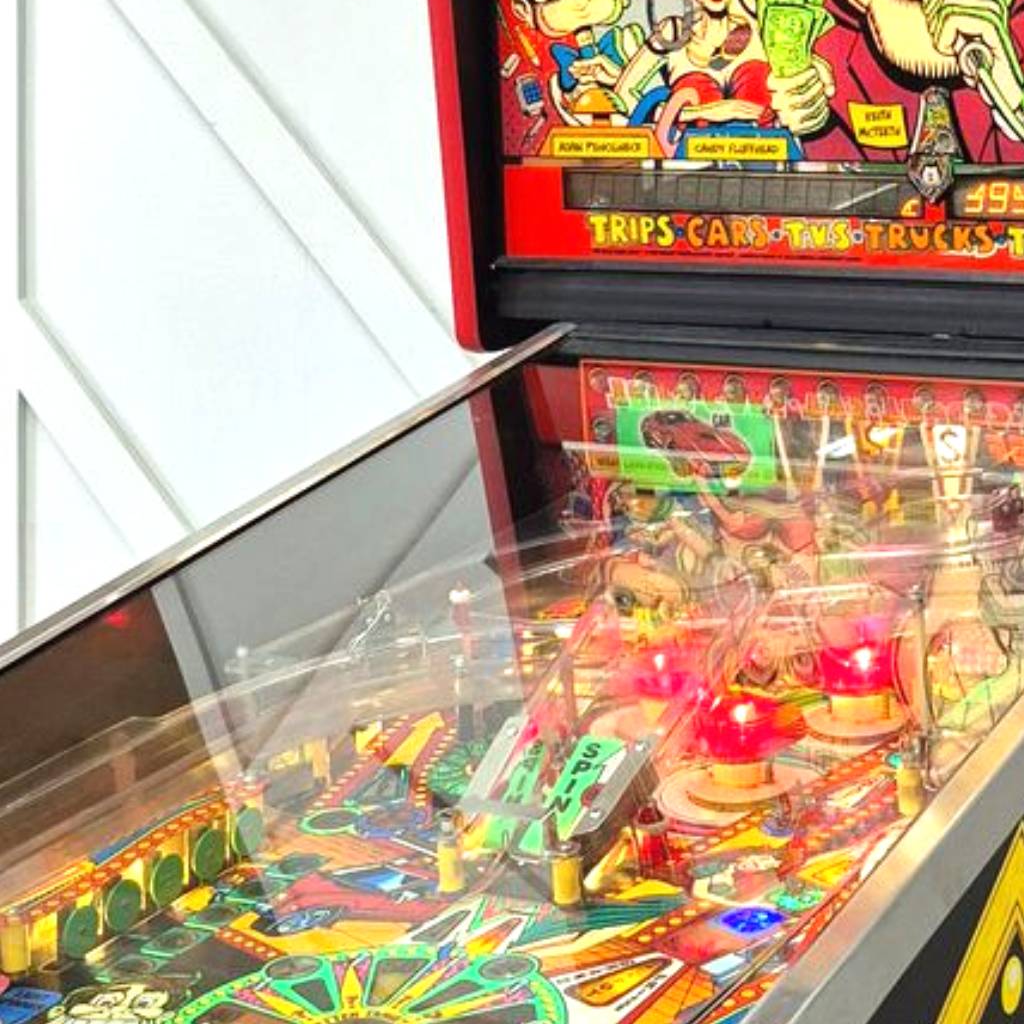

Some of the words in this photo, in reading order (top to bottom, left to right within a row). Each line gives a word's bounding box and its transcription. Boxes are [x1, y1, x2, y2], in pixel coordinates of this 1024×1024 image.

[589, 213, 675, 248] TRIPS
[687, 216, 769, 251] CARS
[864, 222, 995, 255] TRUCKS
[545, 741, 602, 813] SPIN
